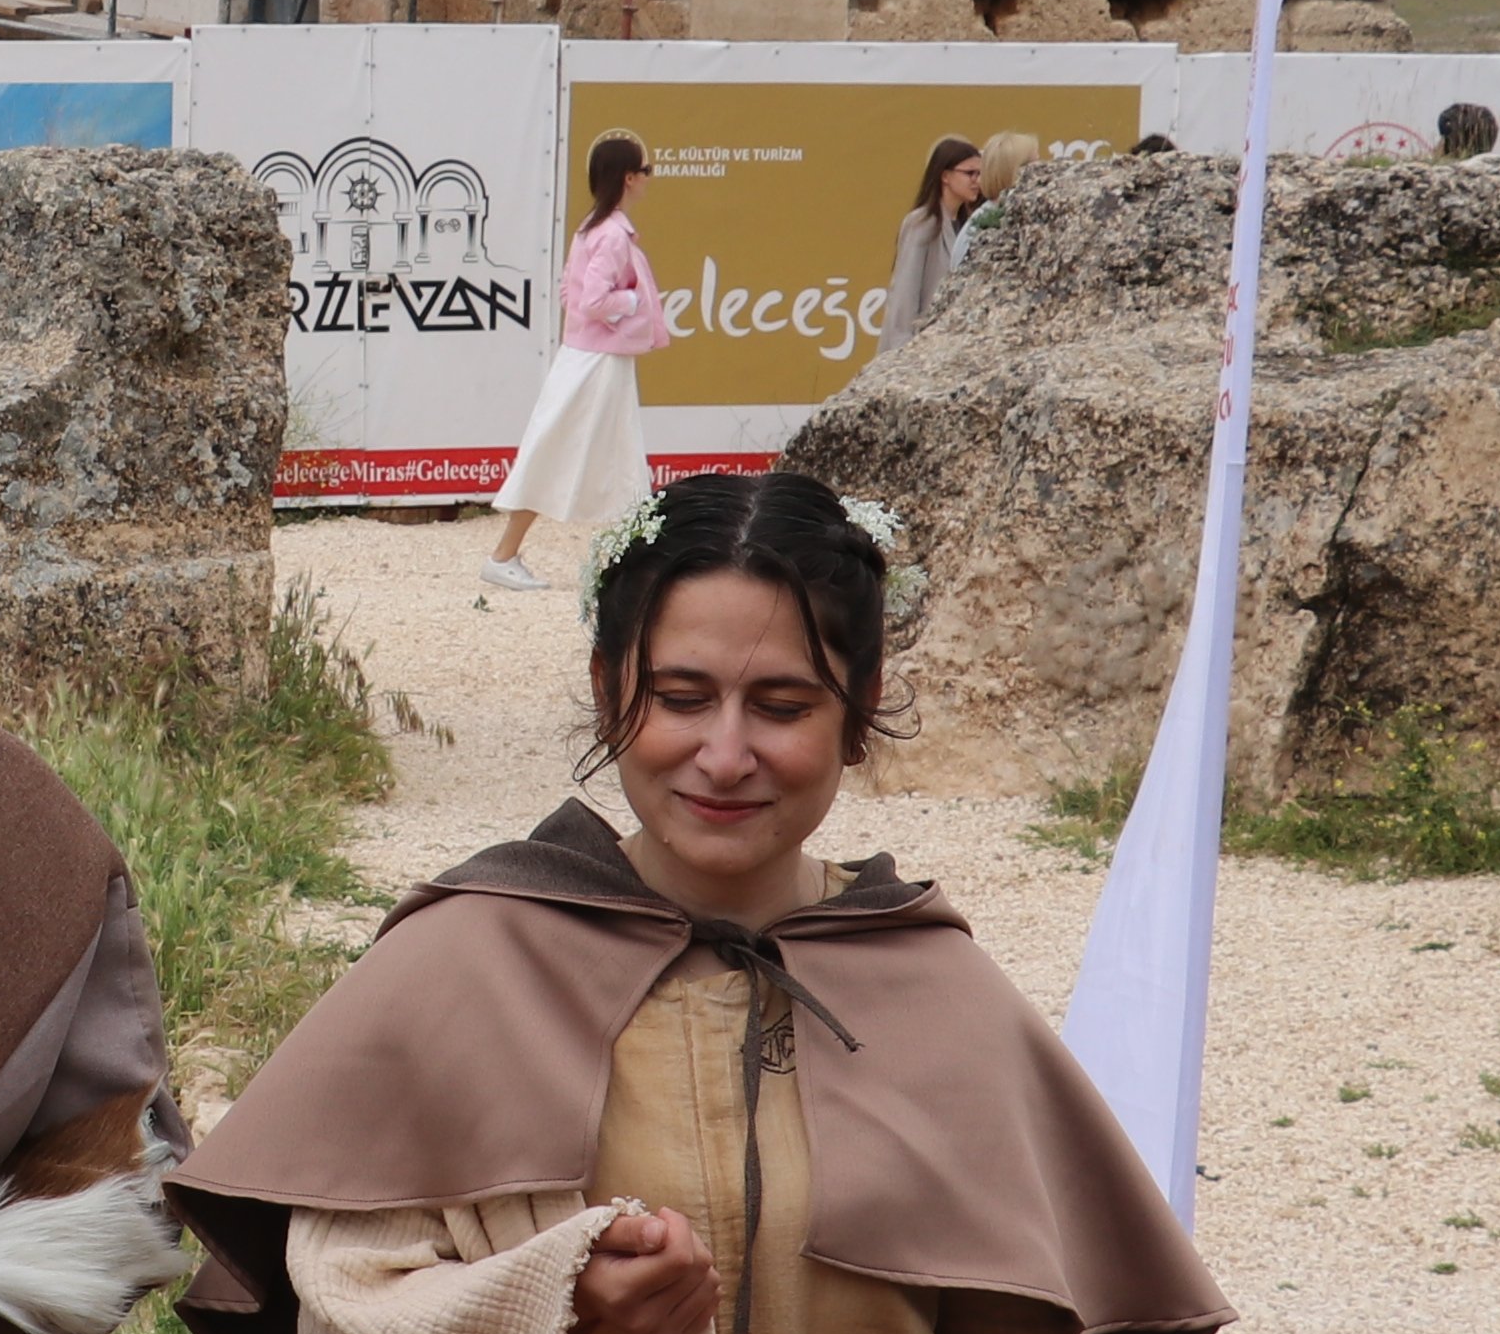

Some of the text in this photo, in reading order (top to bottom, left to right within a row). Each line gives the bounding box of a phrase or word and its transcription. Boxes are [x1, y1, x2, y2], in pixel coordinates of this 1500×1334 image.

[654, 146, 803, 161] T.C. KÜLTÜR VE TURİZM
[654, 163, 726, 177] BAKANLIĞI
[658, 255, 888, 360] eleceğe
